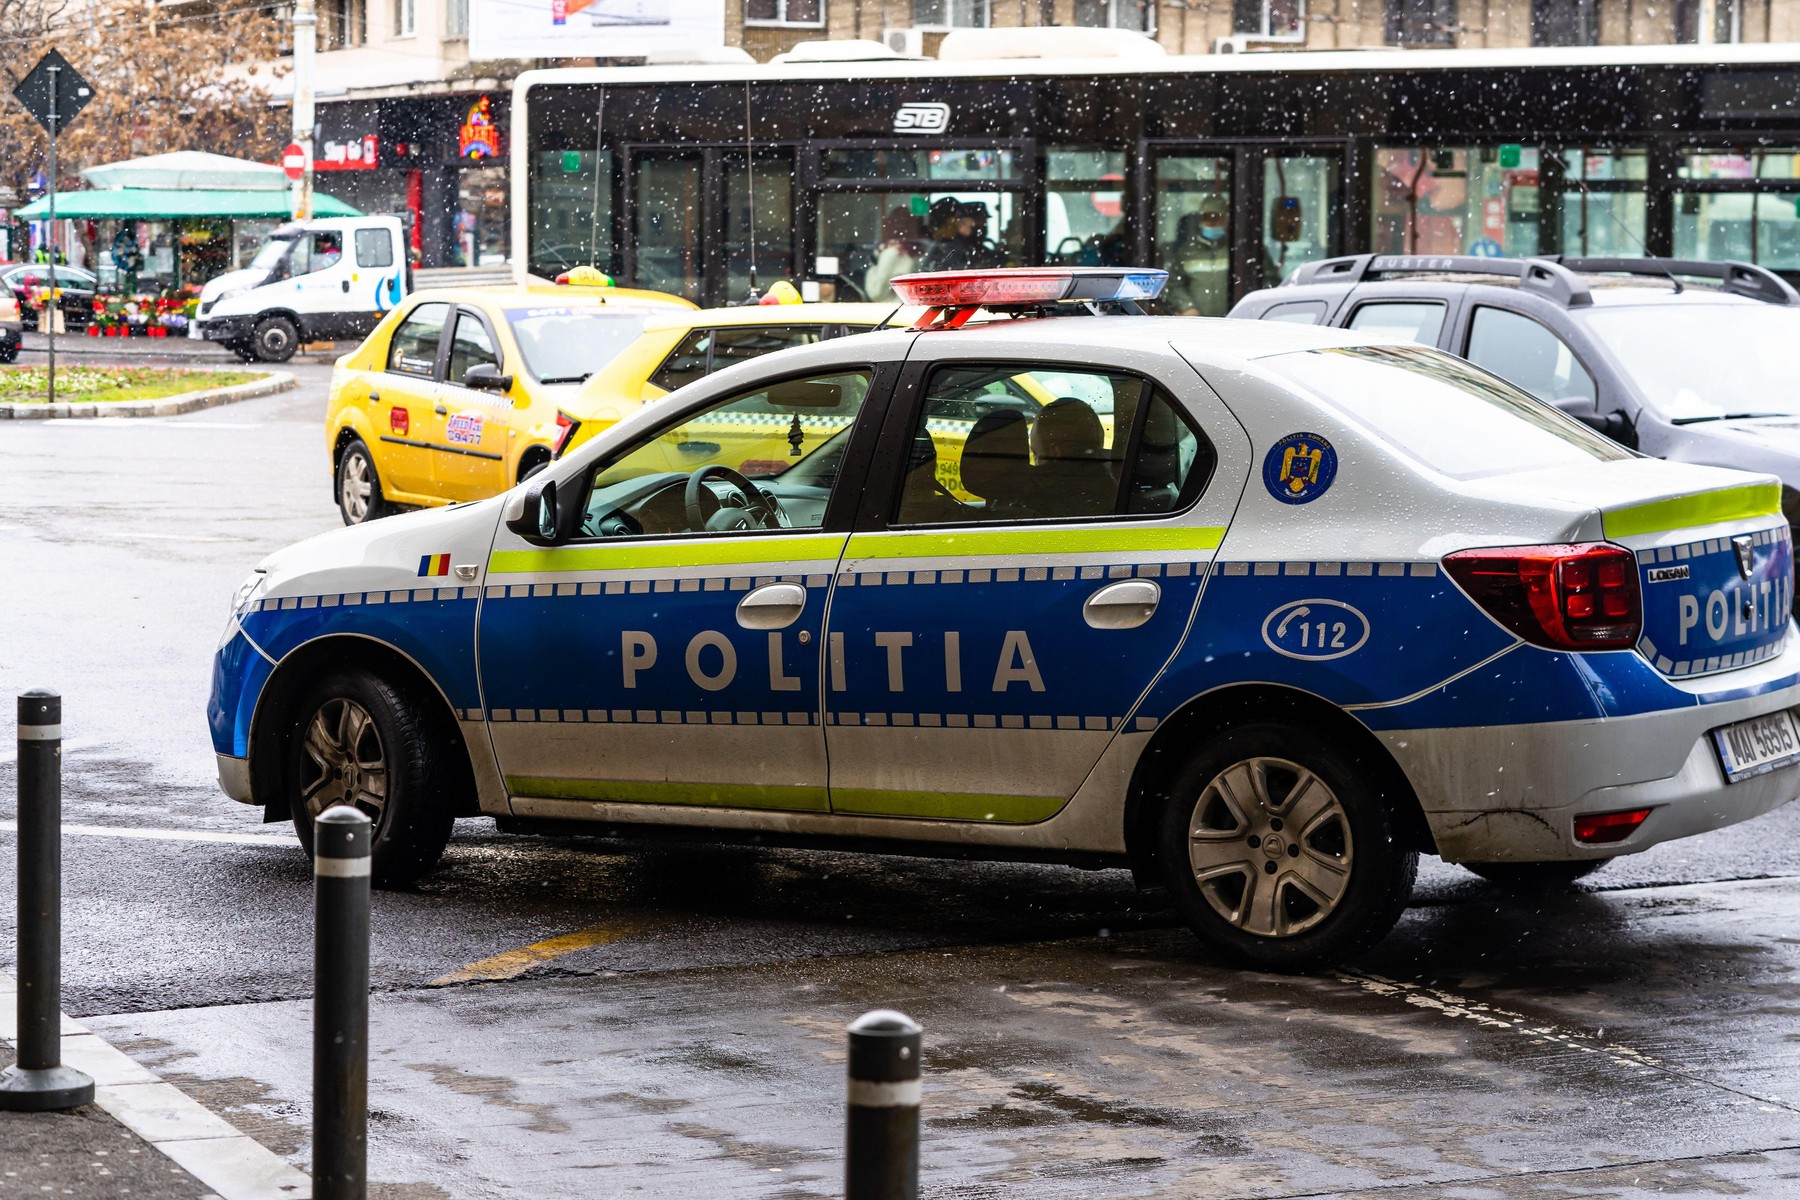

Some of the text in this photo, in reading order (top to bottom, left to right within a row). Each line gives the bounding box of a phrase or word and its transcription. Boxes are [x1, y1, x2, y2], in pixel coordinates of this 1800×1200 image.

[893, 107, 946, 128] STB
[1374, 258, 1453, 269] DUSTER
[455, 432, 481, 445] 9477
[1648, 565, 1690, 583] LOGAN
[1679, 575, 1791, 645] POLITIA
[1300, 622, 1346, 648] 112
[621, 630, 1046, 692] POLITIA
[1727, 713, 1793, 766] MAI 56515
